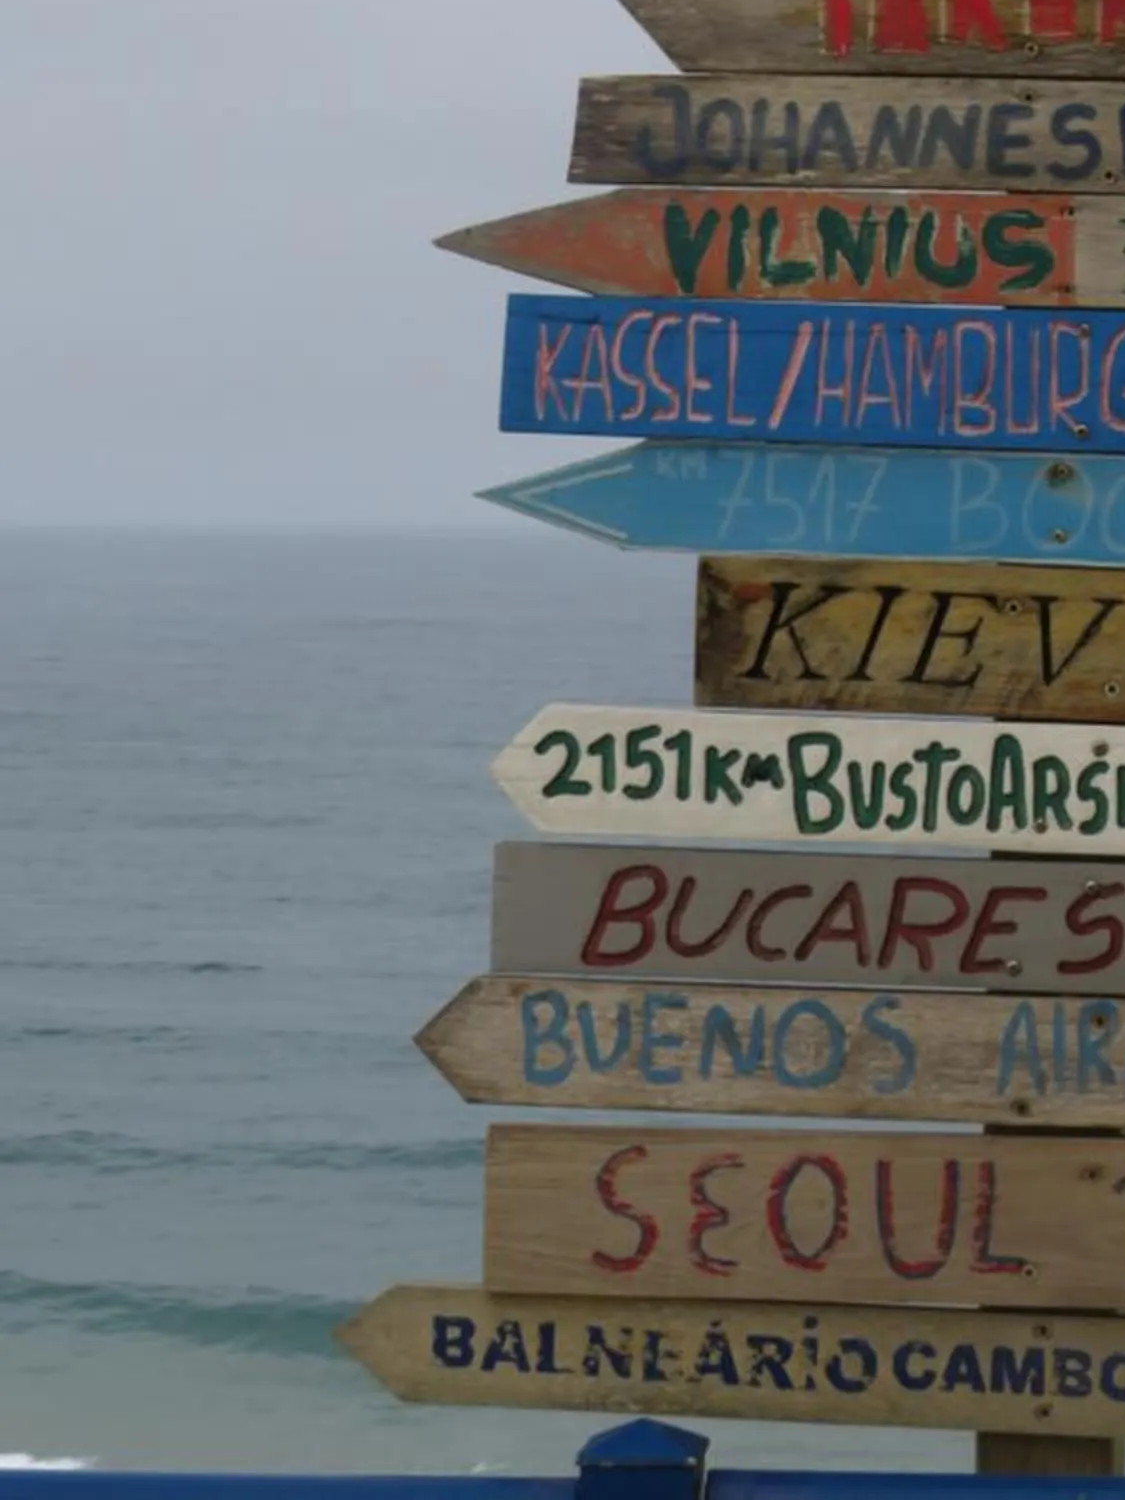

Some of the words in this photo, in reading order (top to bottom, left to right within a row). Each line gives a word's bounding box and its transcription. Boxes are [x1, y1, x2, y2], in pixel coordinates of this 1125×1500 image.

[663, 202, 1055, 295] VILNIUS
[716, 451, 890, 545] 7517
[738, 581, 1125, 688] KIEV
[519, 988, 919, 1096] BUENOS
[590, 1144, 1030, 1280] SEOUL
